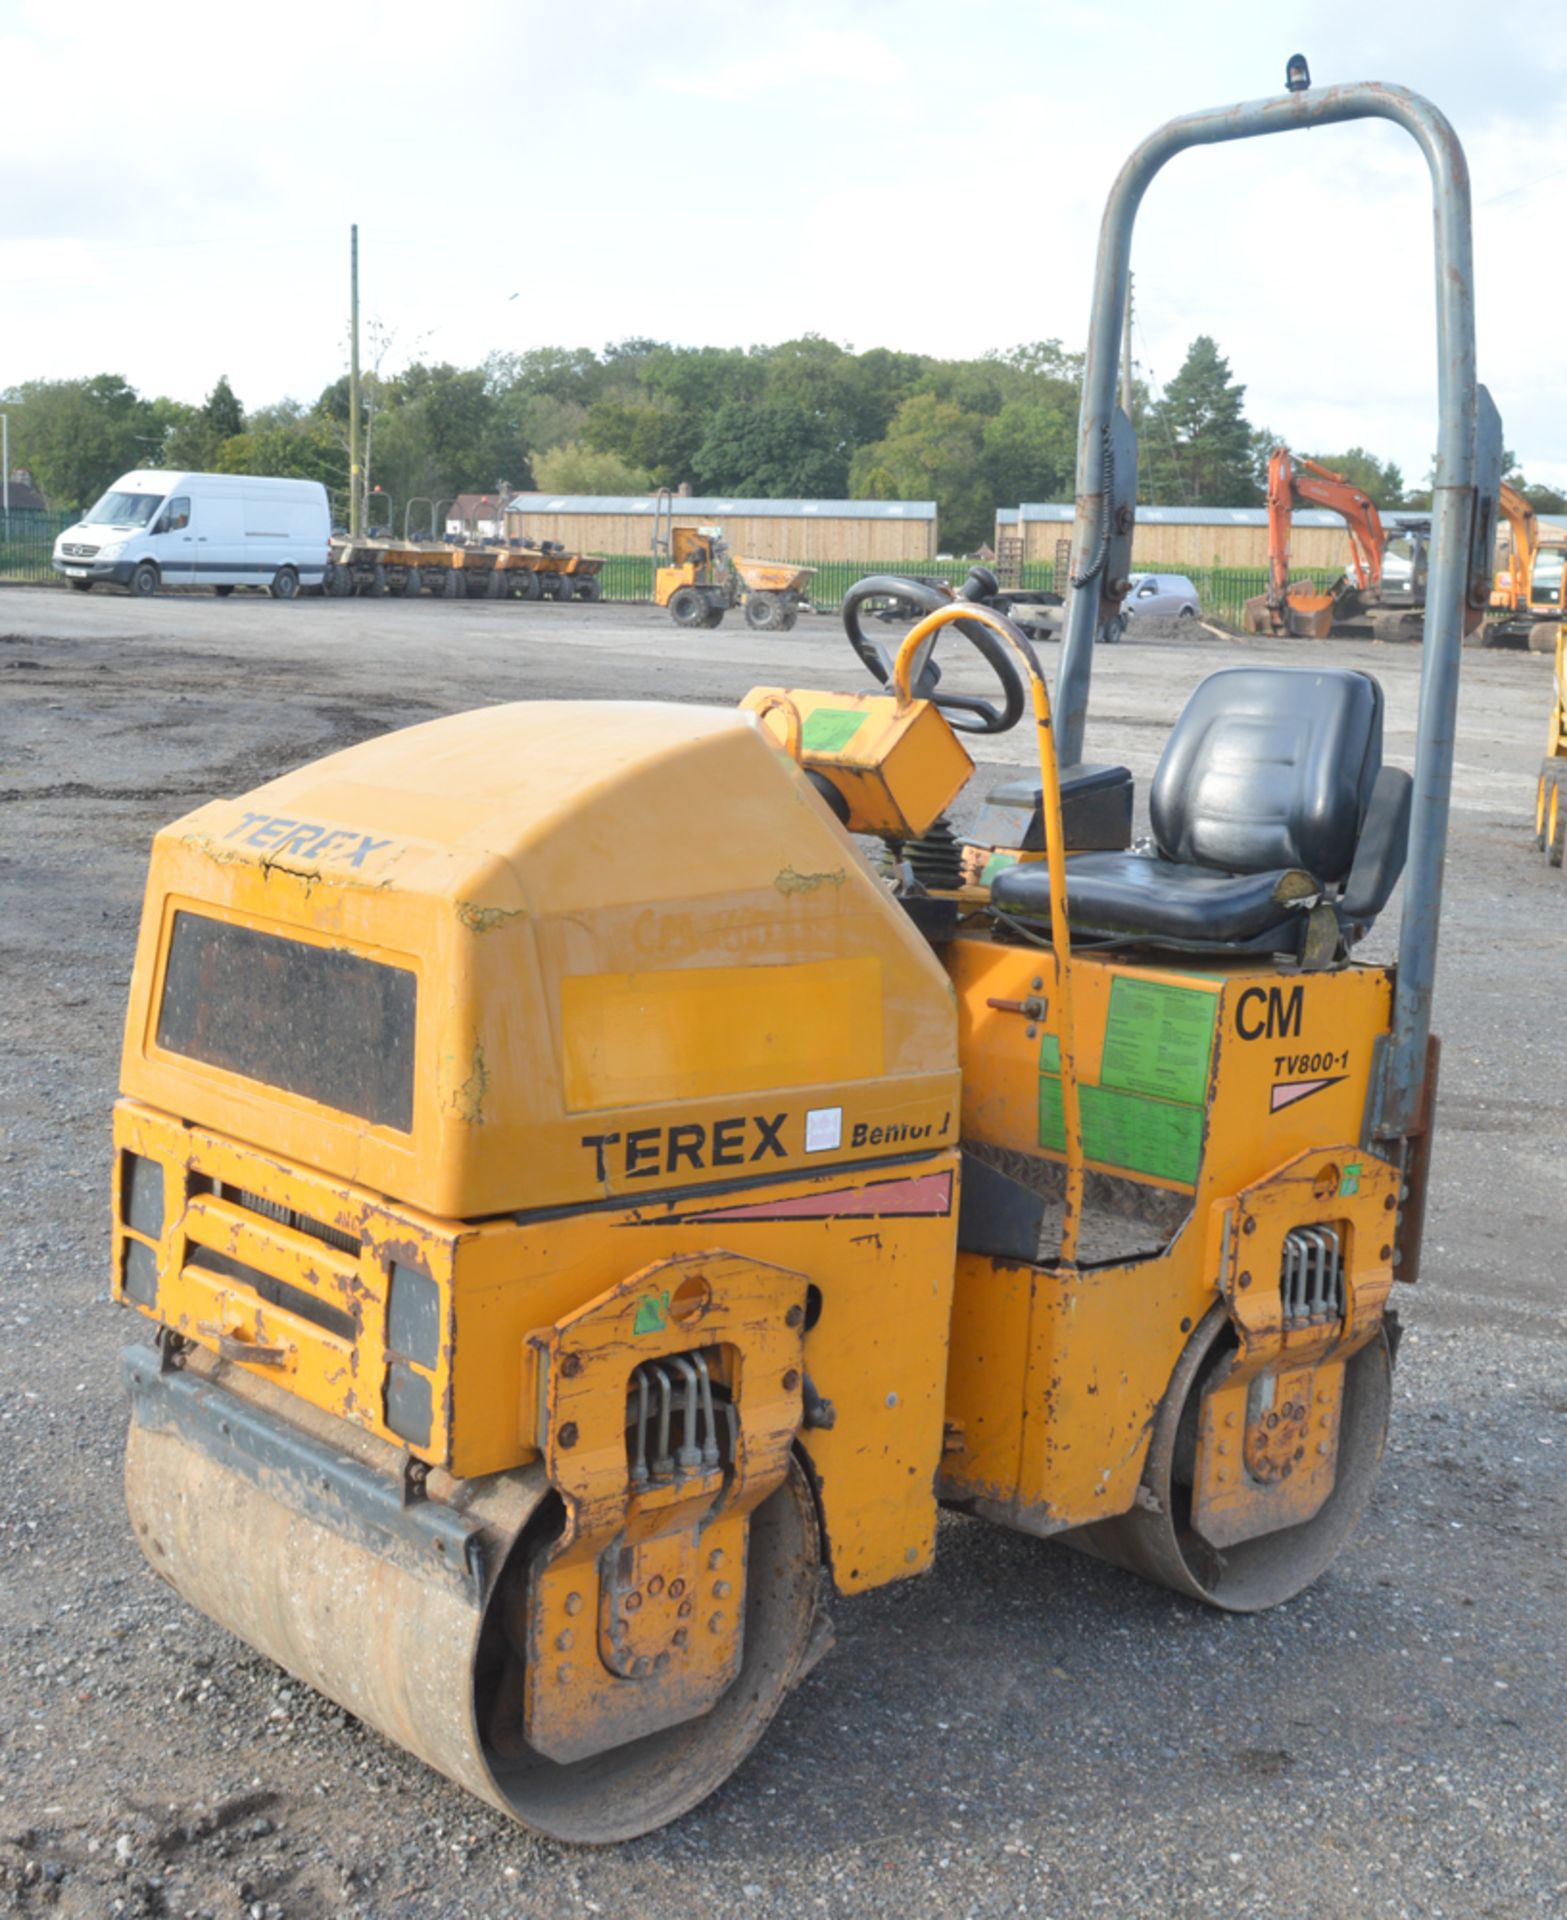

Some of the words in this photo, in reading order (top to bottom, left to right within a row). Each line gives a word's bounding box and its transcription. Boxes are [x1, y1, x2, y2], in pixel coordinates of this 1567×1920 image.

[223, 811, 393, 868] TEREX
[1235, 985, 1304, 1042] CM
[581, 1113, 788, 1184] TEREX
